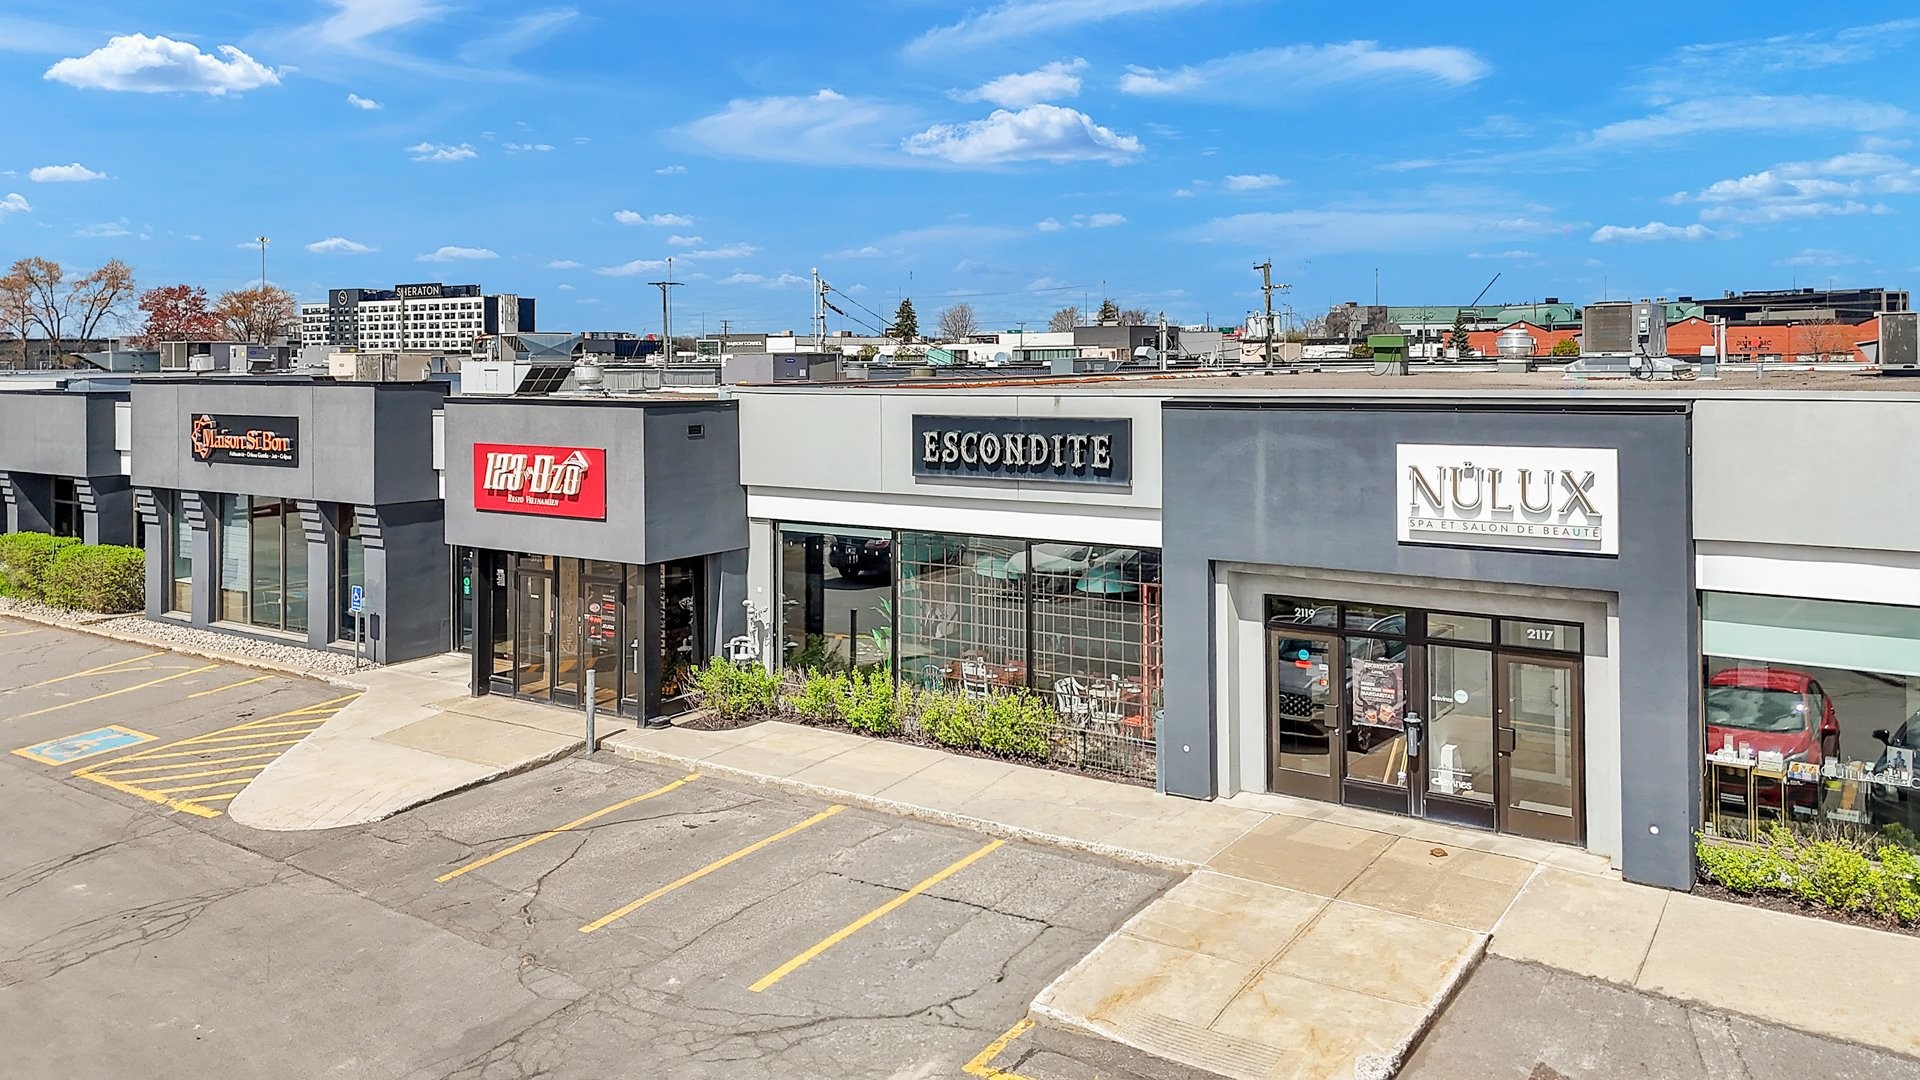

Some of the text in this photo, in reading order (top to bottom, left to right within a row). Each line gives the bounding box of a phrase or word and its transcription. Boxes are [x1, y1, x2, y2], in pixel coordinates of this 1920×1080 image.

[397, 286, 440, 296] SHERATON
[202, 429, 245, 449] Maison
[262, 431, 289, 451] Bon
[922, 431, 1110, 469] ESCONDITE
[1408, 462, 1601, 516] NÜLUX
[1409, 519, 1599, 538] SPA ET SALON DE BEAUTÉ
[1294, 607, 1315, 618] 2119
[1526, 628, 1554, 641] 2117
